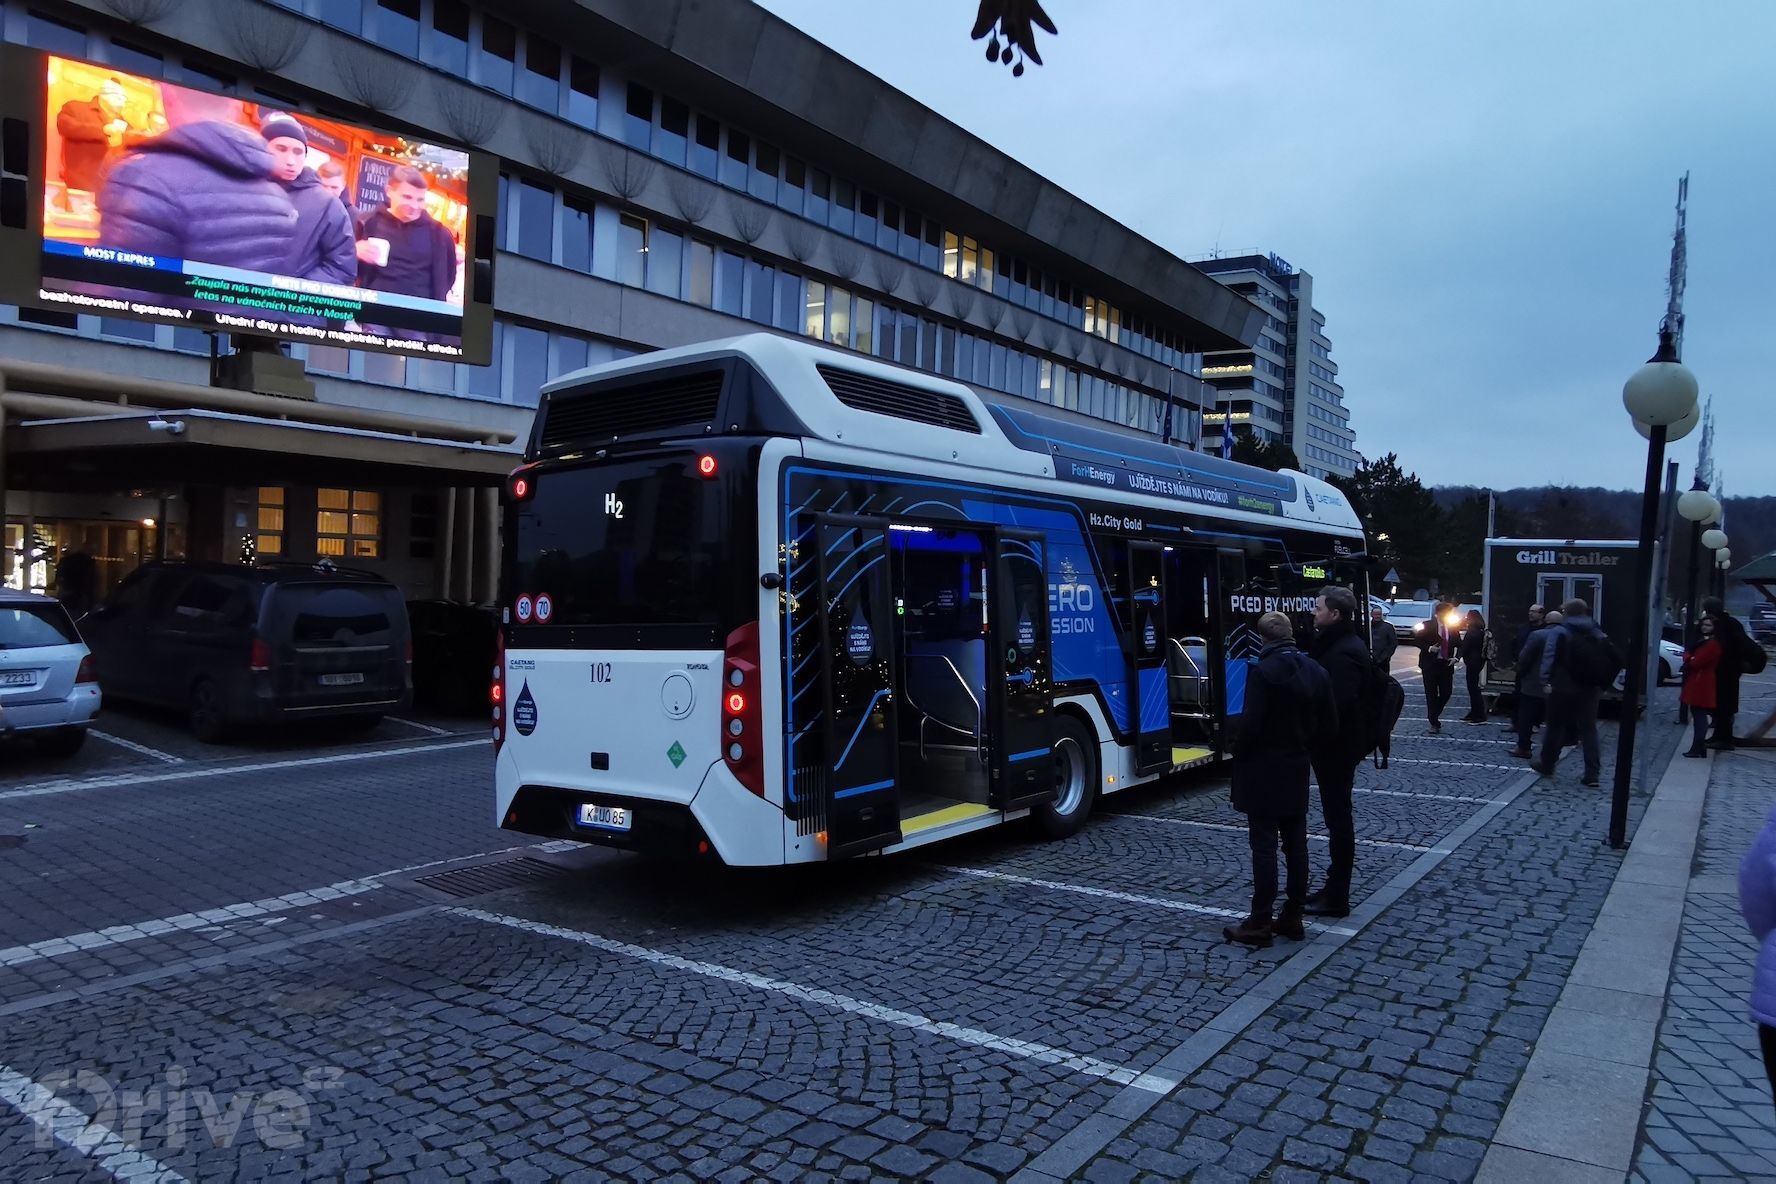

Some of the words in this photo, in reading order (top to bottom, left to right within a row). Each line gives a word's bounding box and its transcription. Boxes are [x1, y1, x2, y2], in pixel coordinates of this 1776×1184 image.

[83, 246, 116, 261] MOST
[117, 251, 156, 267] EXPRES
[256, 319, 278, 333] dny
[279, 324, 289, 333] a
[289, 323, 327, 339] hodiny
[1123, 517, 1143, 531] Gold
[1516, 550, 1556, 565] Grill
[1558, 551, 1619, 566] Trailer
[520, 601, 530, 616] 50
[538, 601, 548, 616] 70
[1264, 596, 1280, 613] BY
[5, 673, 32, 684] 2233
[589, 662, 612, 684] 102
[612, 811, 625, 825] 85
